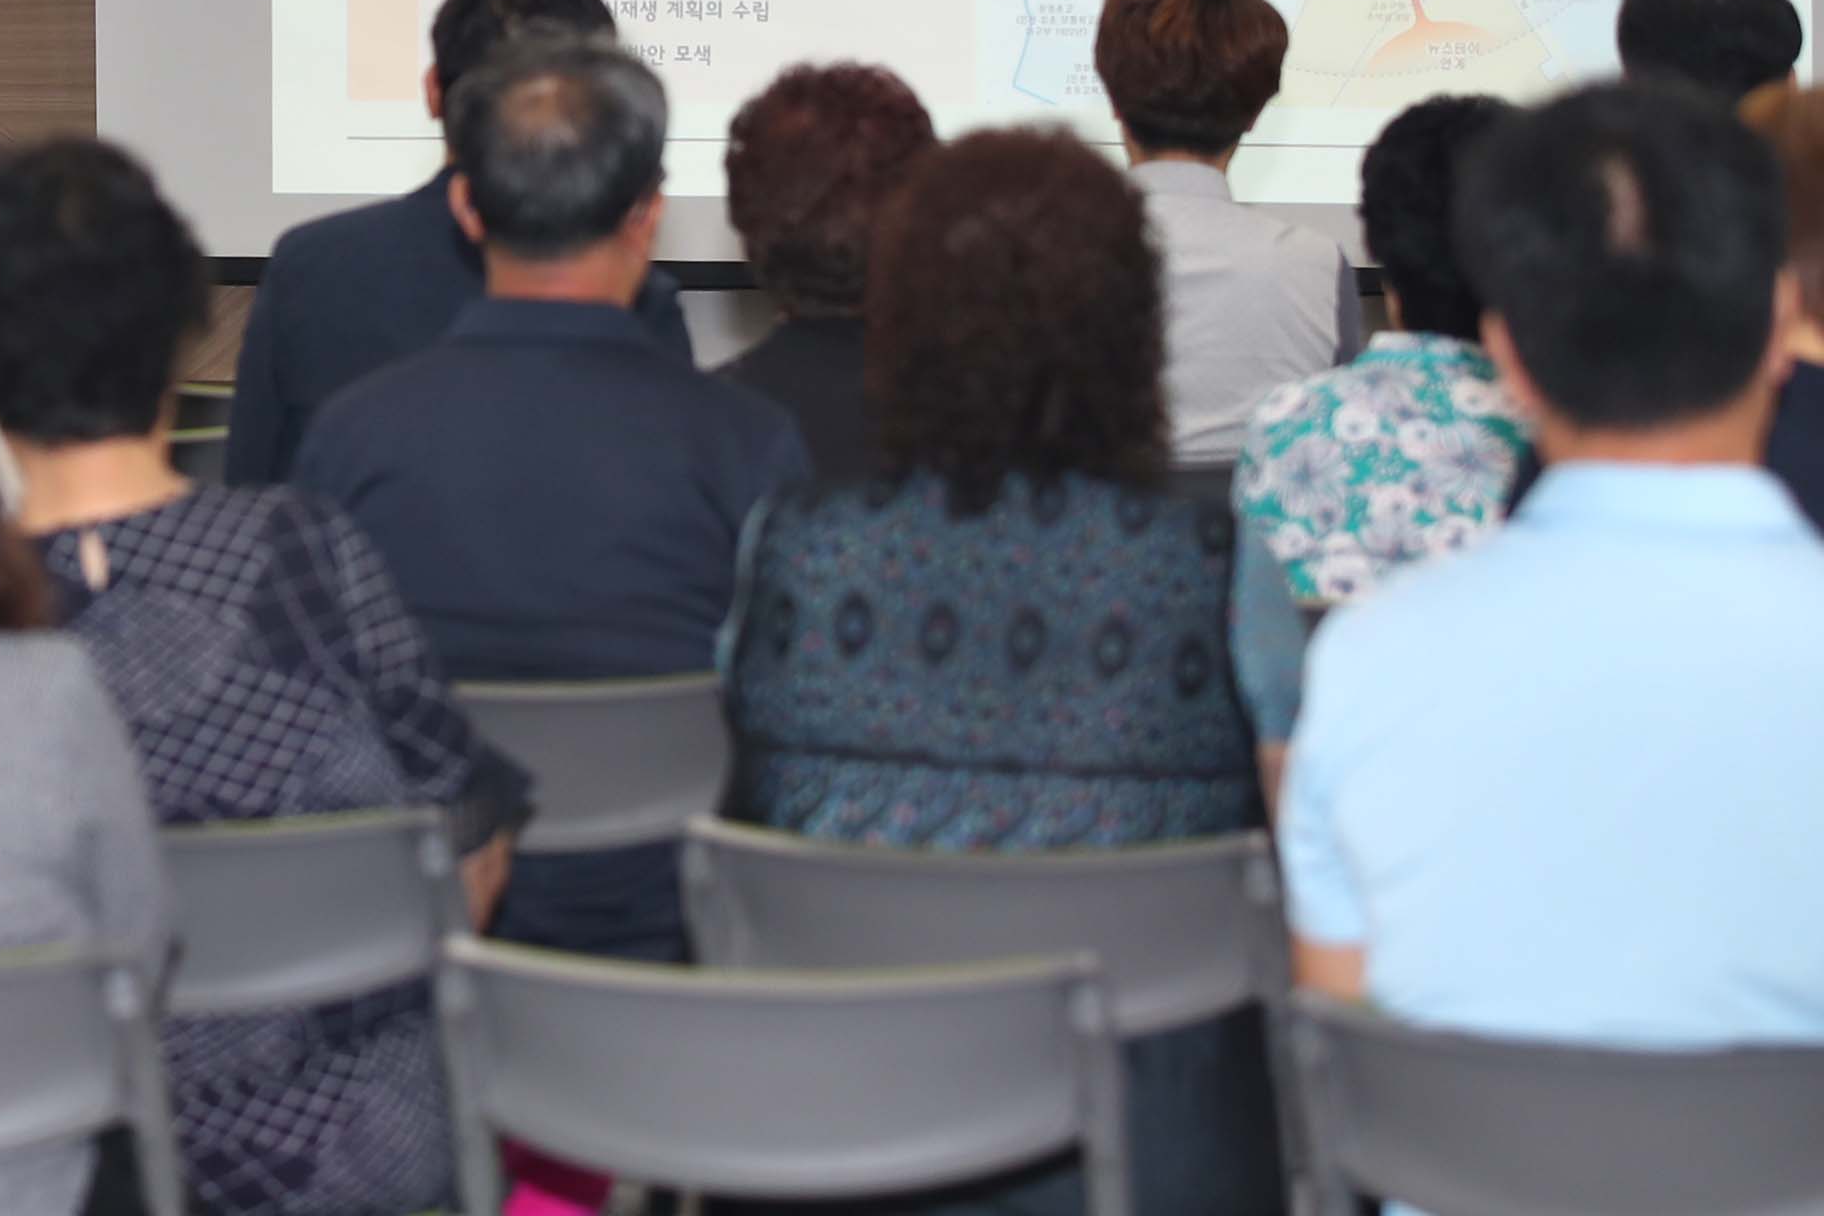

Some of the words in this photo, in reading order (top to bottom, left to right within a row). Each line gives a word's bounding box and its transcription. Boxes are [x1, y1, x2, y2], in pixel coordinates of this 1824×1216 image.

[667, 0, 722, 21] 계획의
[732, 1, 768, 22] 수립
[674, 45, 711, 66] 모색
